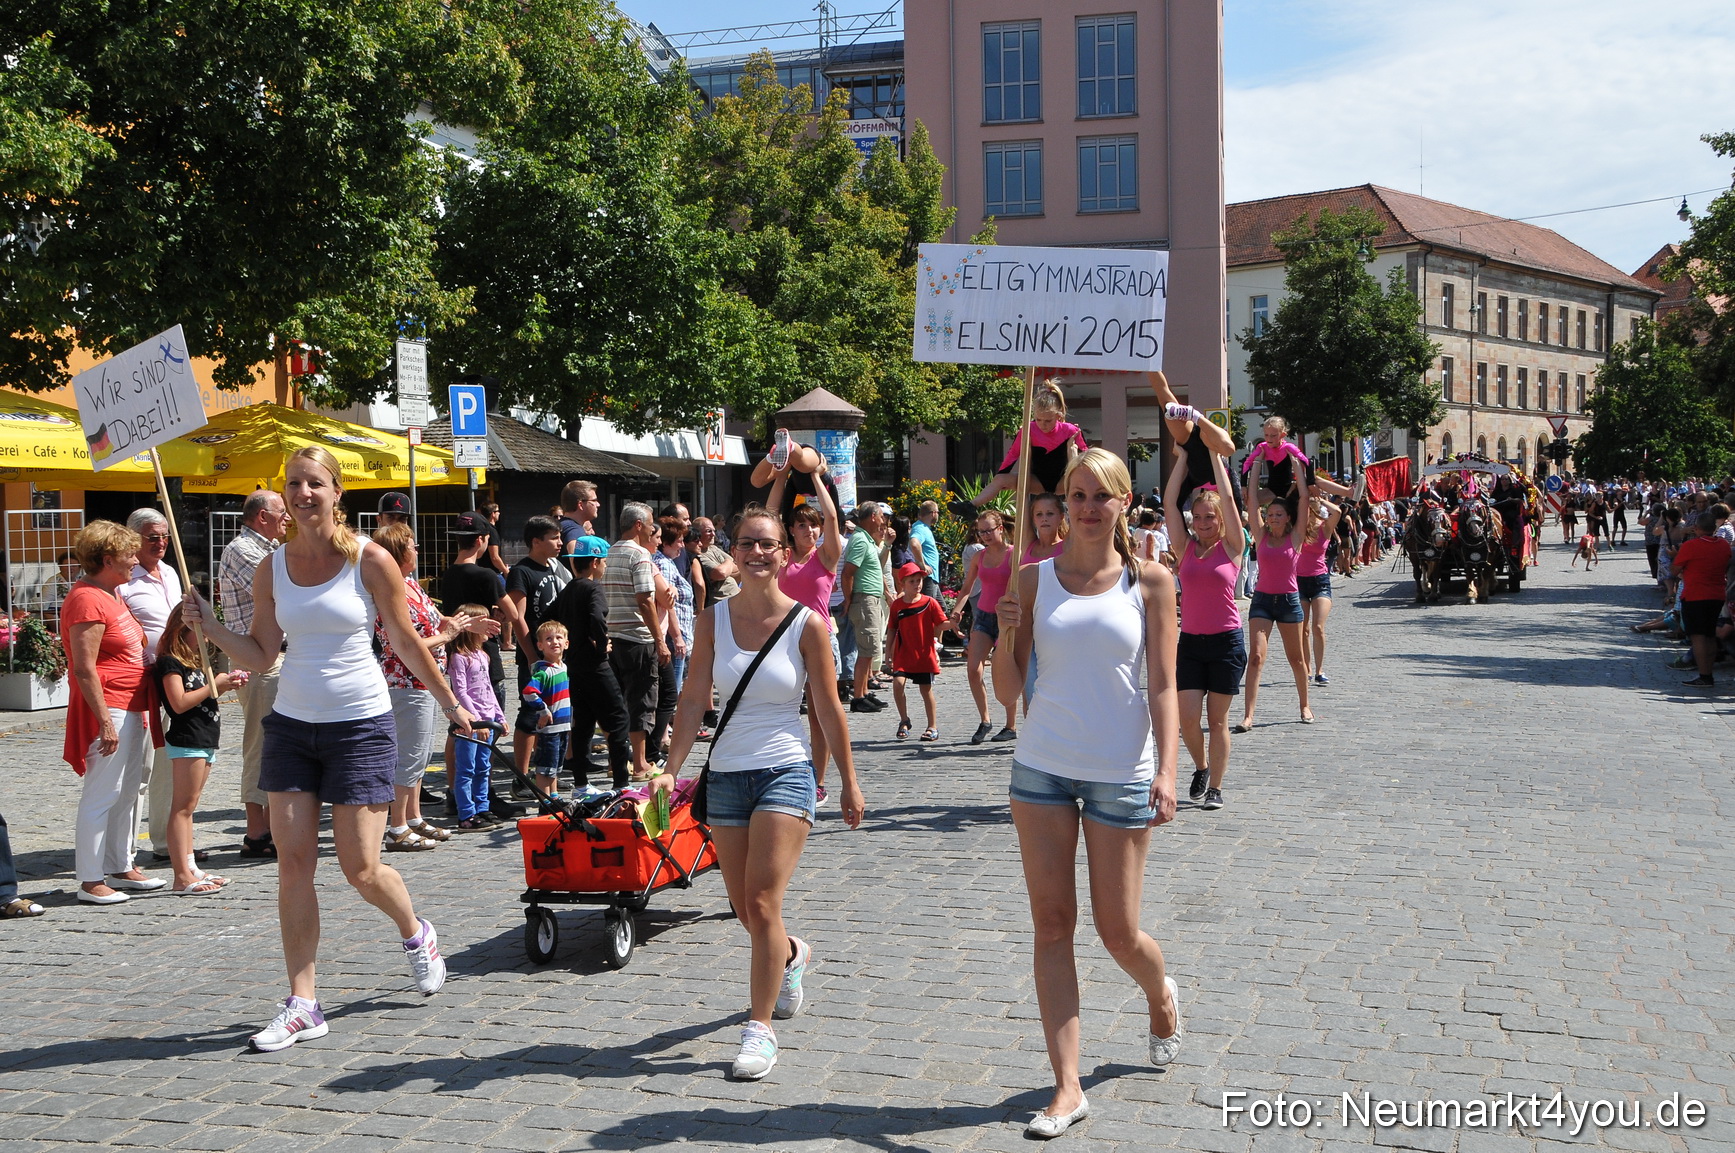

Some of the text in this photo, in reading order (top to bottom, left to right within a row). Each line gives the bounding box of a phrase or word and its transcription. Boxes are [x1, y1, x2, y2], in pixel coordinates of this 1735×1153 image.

[919, 248, 1167, 299] WELTGYMNASTRADA
[1074, 315, 1163, 359] 2015
[400, 354, 424, 363] Parkschein
[402, 364, 422, 373] werktags
[213, 387, 252, 409] Theke
[457, 391, 478, 430] P
[33, 445, 57, 457] Café
[368, 460, 383, 470] Café
